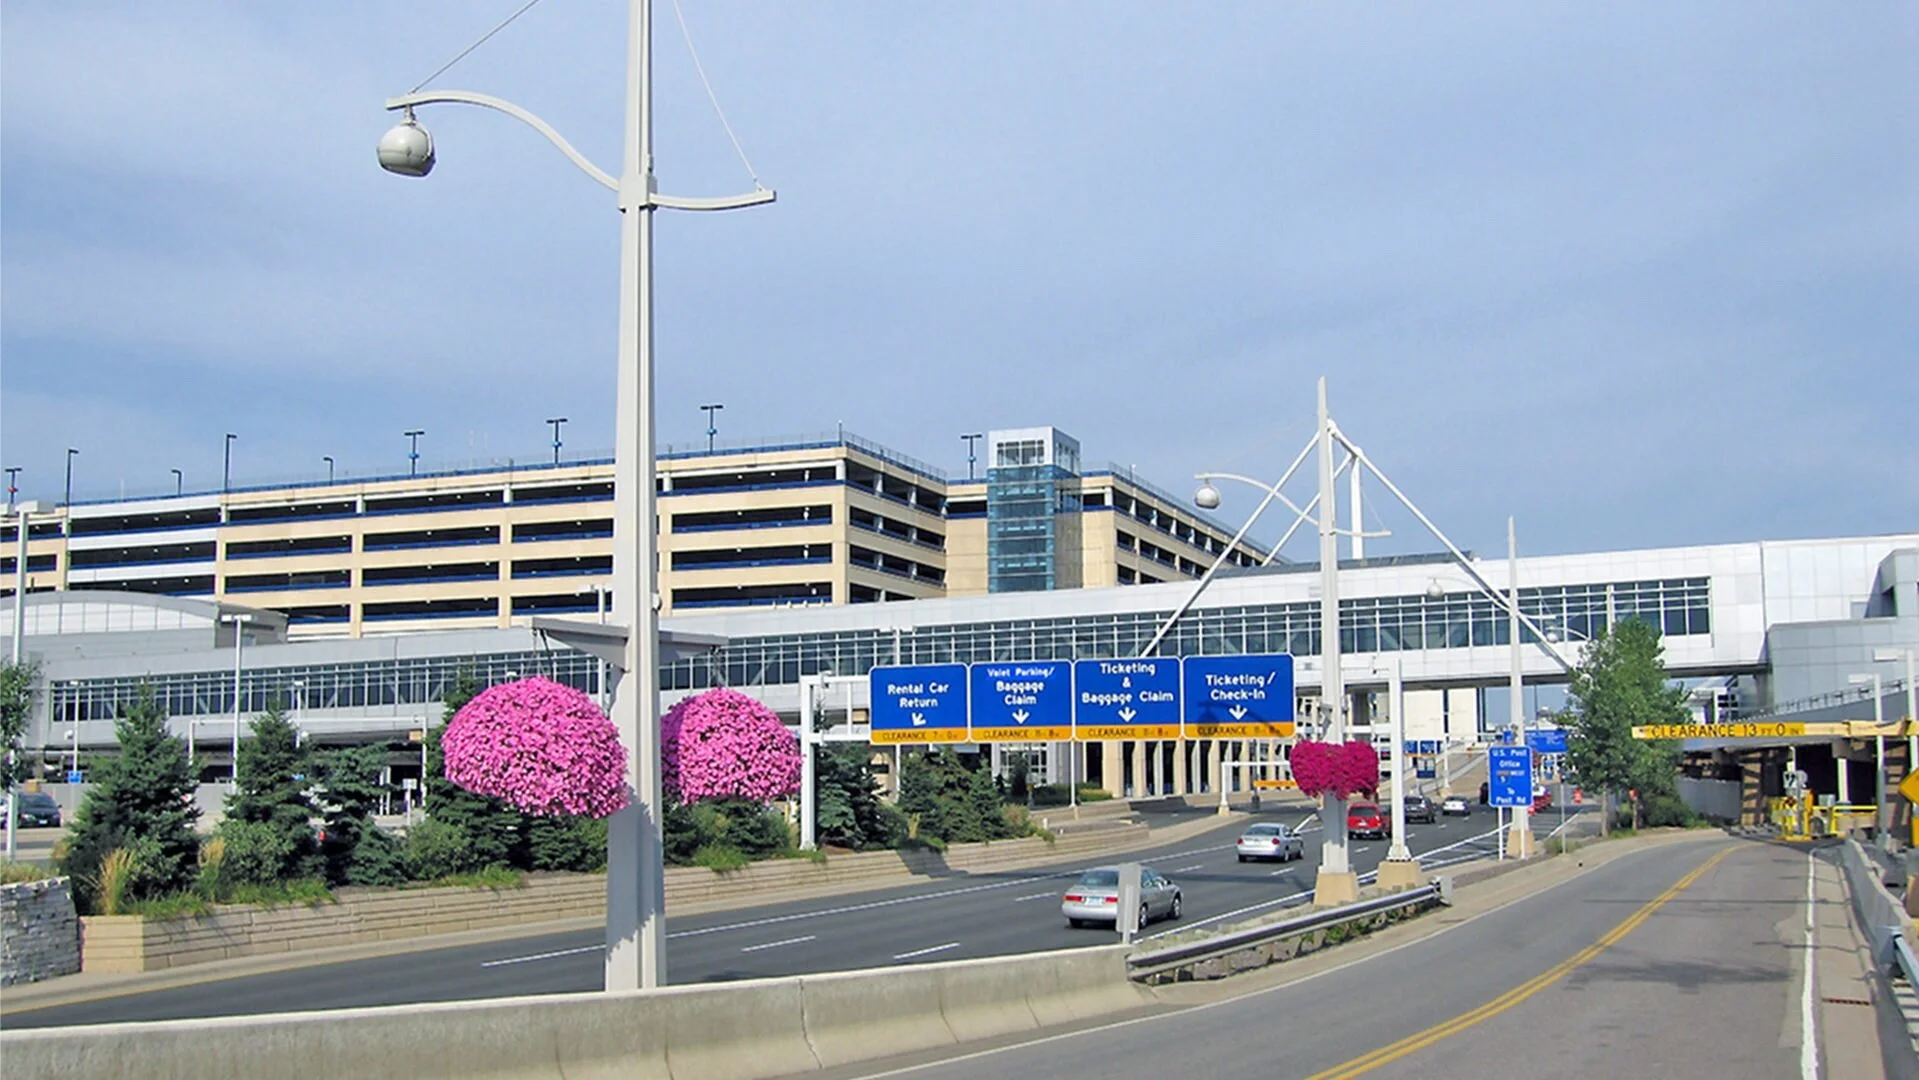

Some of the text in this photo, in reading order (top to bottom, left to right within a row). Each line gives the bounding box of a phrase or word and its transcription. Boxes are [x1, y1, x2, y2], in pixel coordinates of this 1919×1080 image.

[987, 666, 1055, 678] Valet Parking/
[1100, 662, 1156, 676] Ticketing
[996, 680, 1045, 694] Baggage
[1122, 676, 1131, 688] &
[887, 682, 949, 695] Rental Car
[1004, 694, 1037, 705] Claim
[1081, 690, 1174, 706] Baggage Claim
[1210, 689, 1266, 700] Check-In
[899, 697, 939, 708] Return
[983, 729, 1029, 739] CLEARANCE
[1088, 728, 1136, 737] CLEARANCE
[1197, 726, 1247, 736] CLEARANCE
[1651, 724, 1735, 738] CLEARANCE
[1743, 723, 1758, 737] 13
[1775, 722, 1786, 737] 0
[882, 731, 927, 741] CLEARANCE
[1499, 760, 1520, 768] Office
